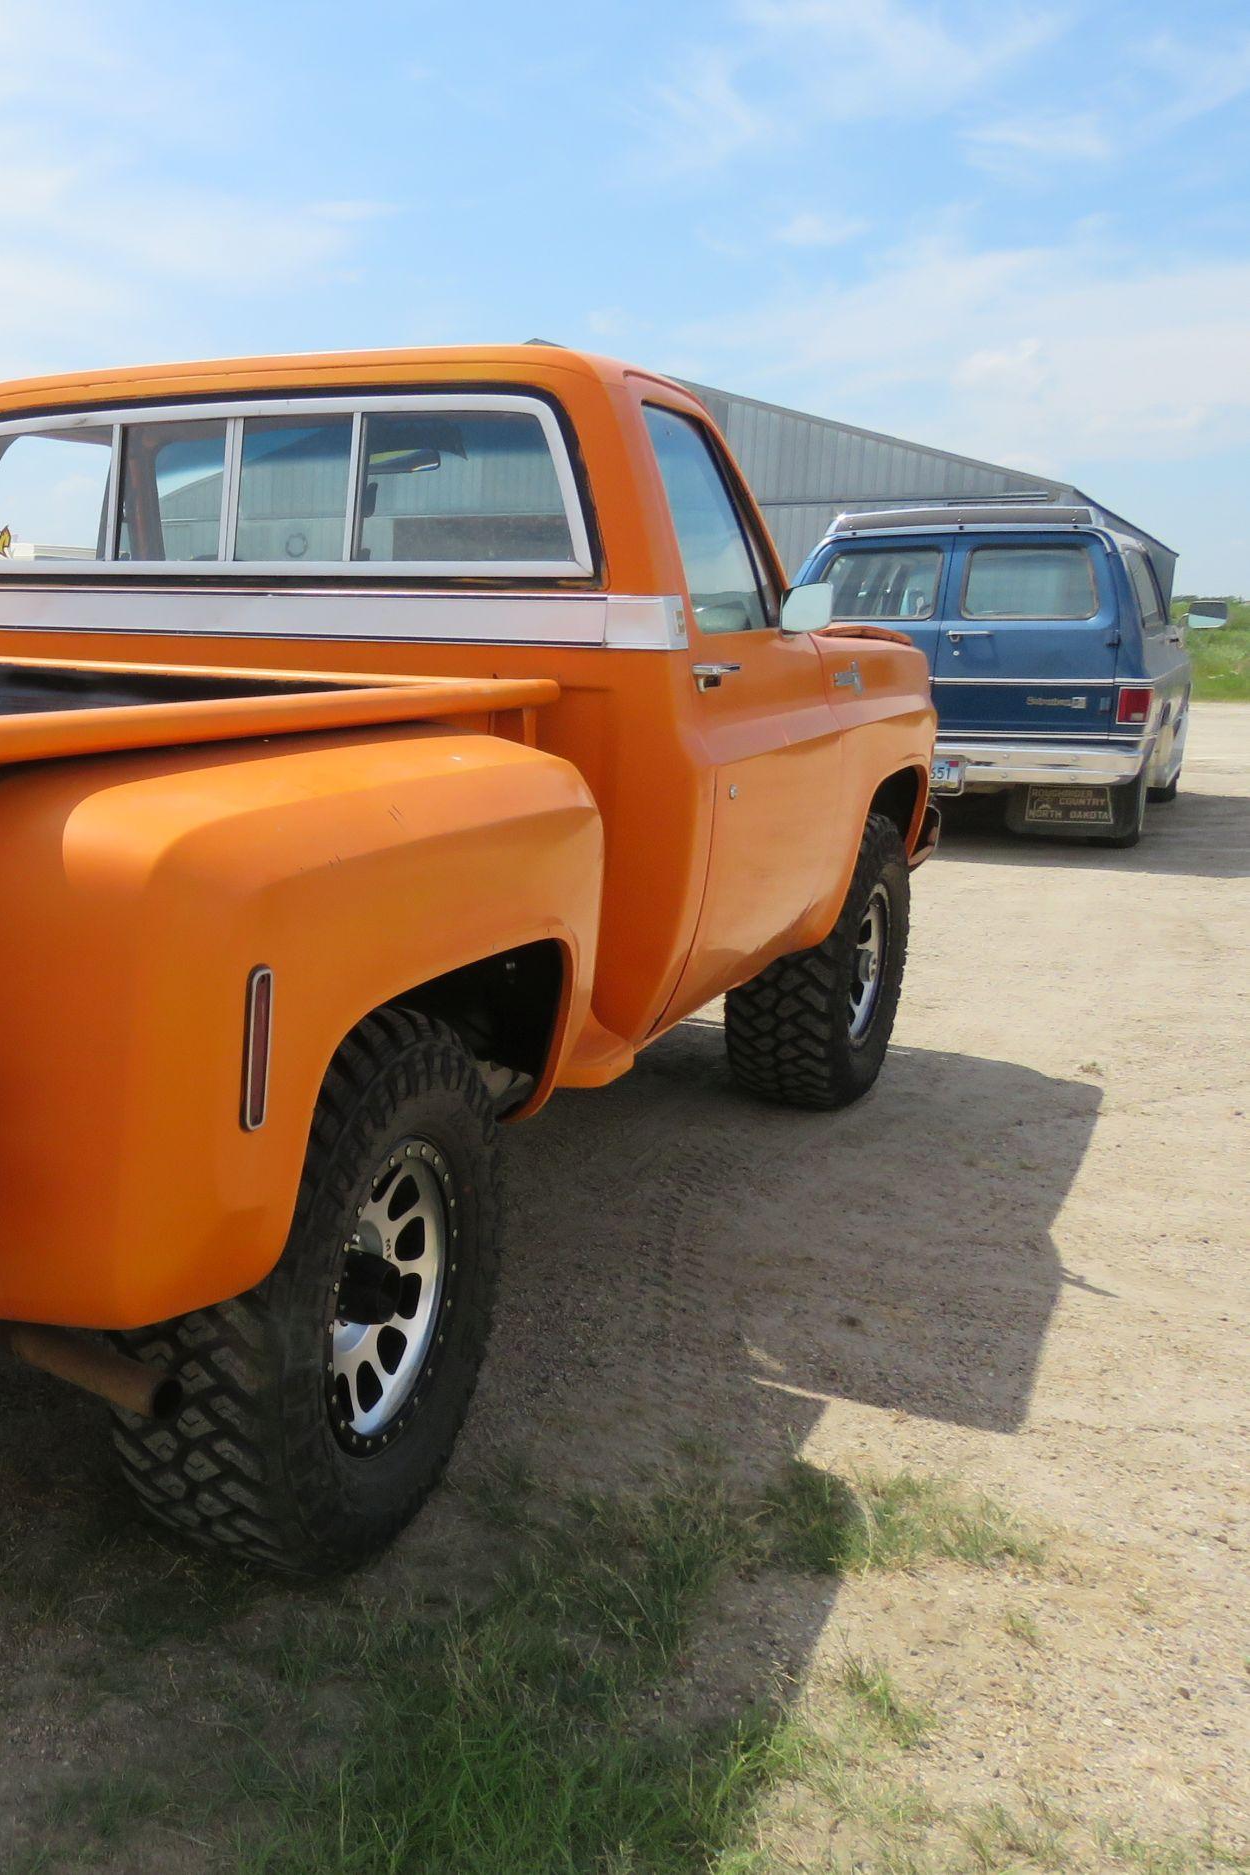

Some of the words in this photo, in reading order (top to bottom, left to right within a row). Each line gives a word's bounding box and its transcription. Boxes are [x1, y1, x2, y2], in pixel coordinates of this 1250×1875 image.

[1059, 798, 1106, 806] COUNTRY
[1028, 810, 1063, 819] NORTH
[1070, 811, 1111, 819] DAKOTA
